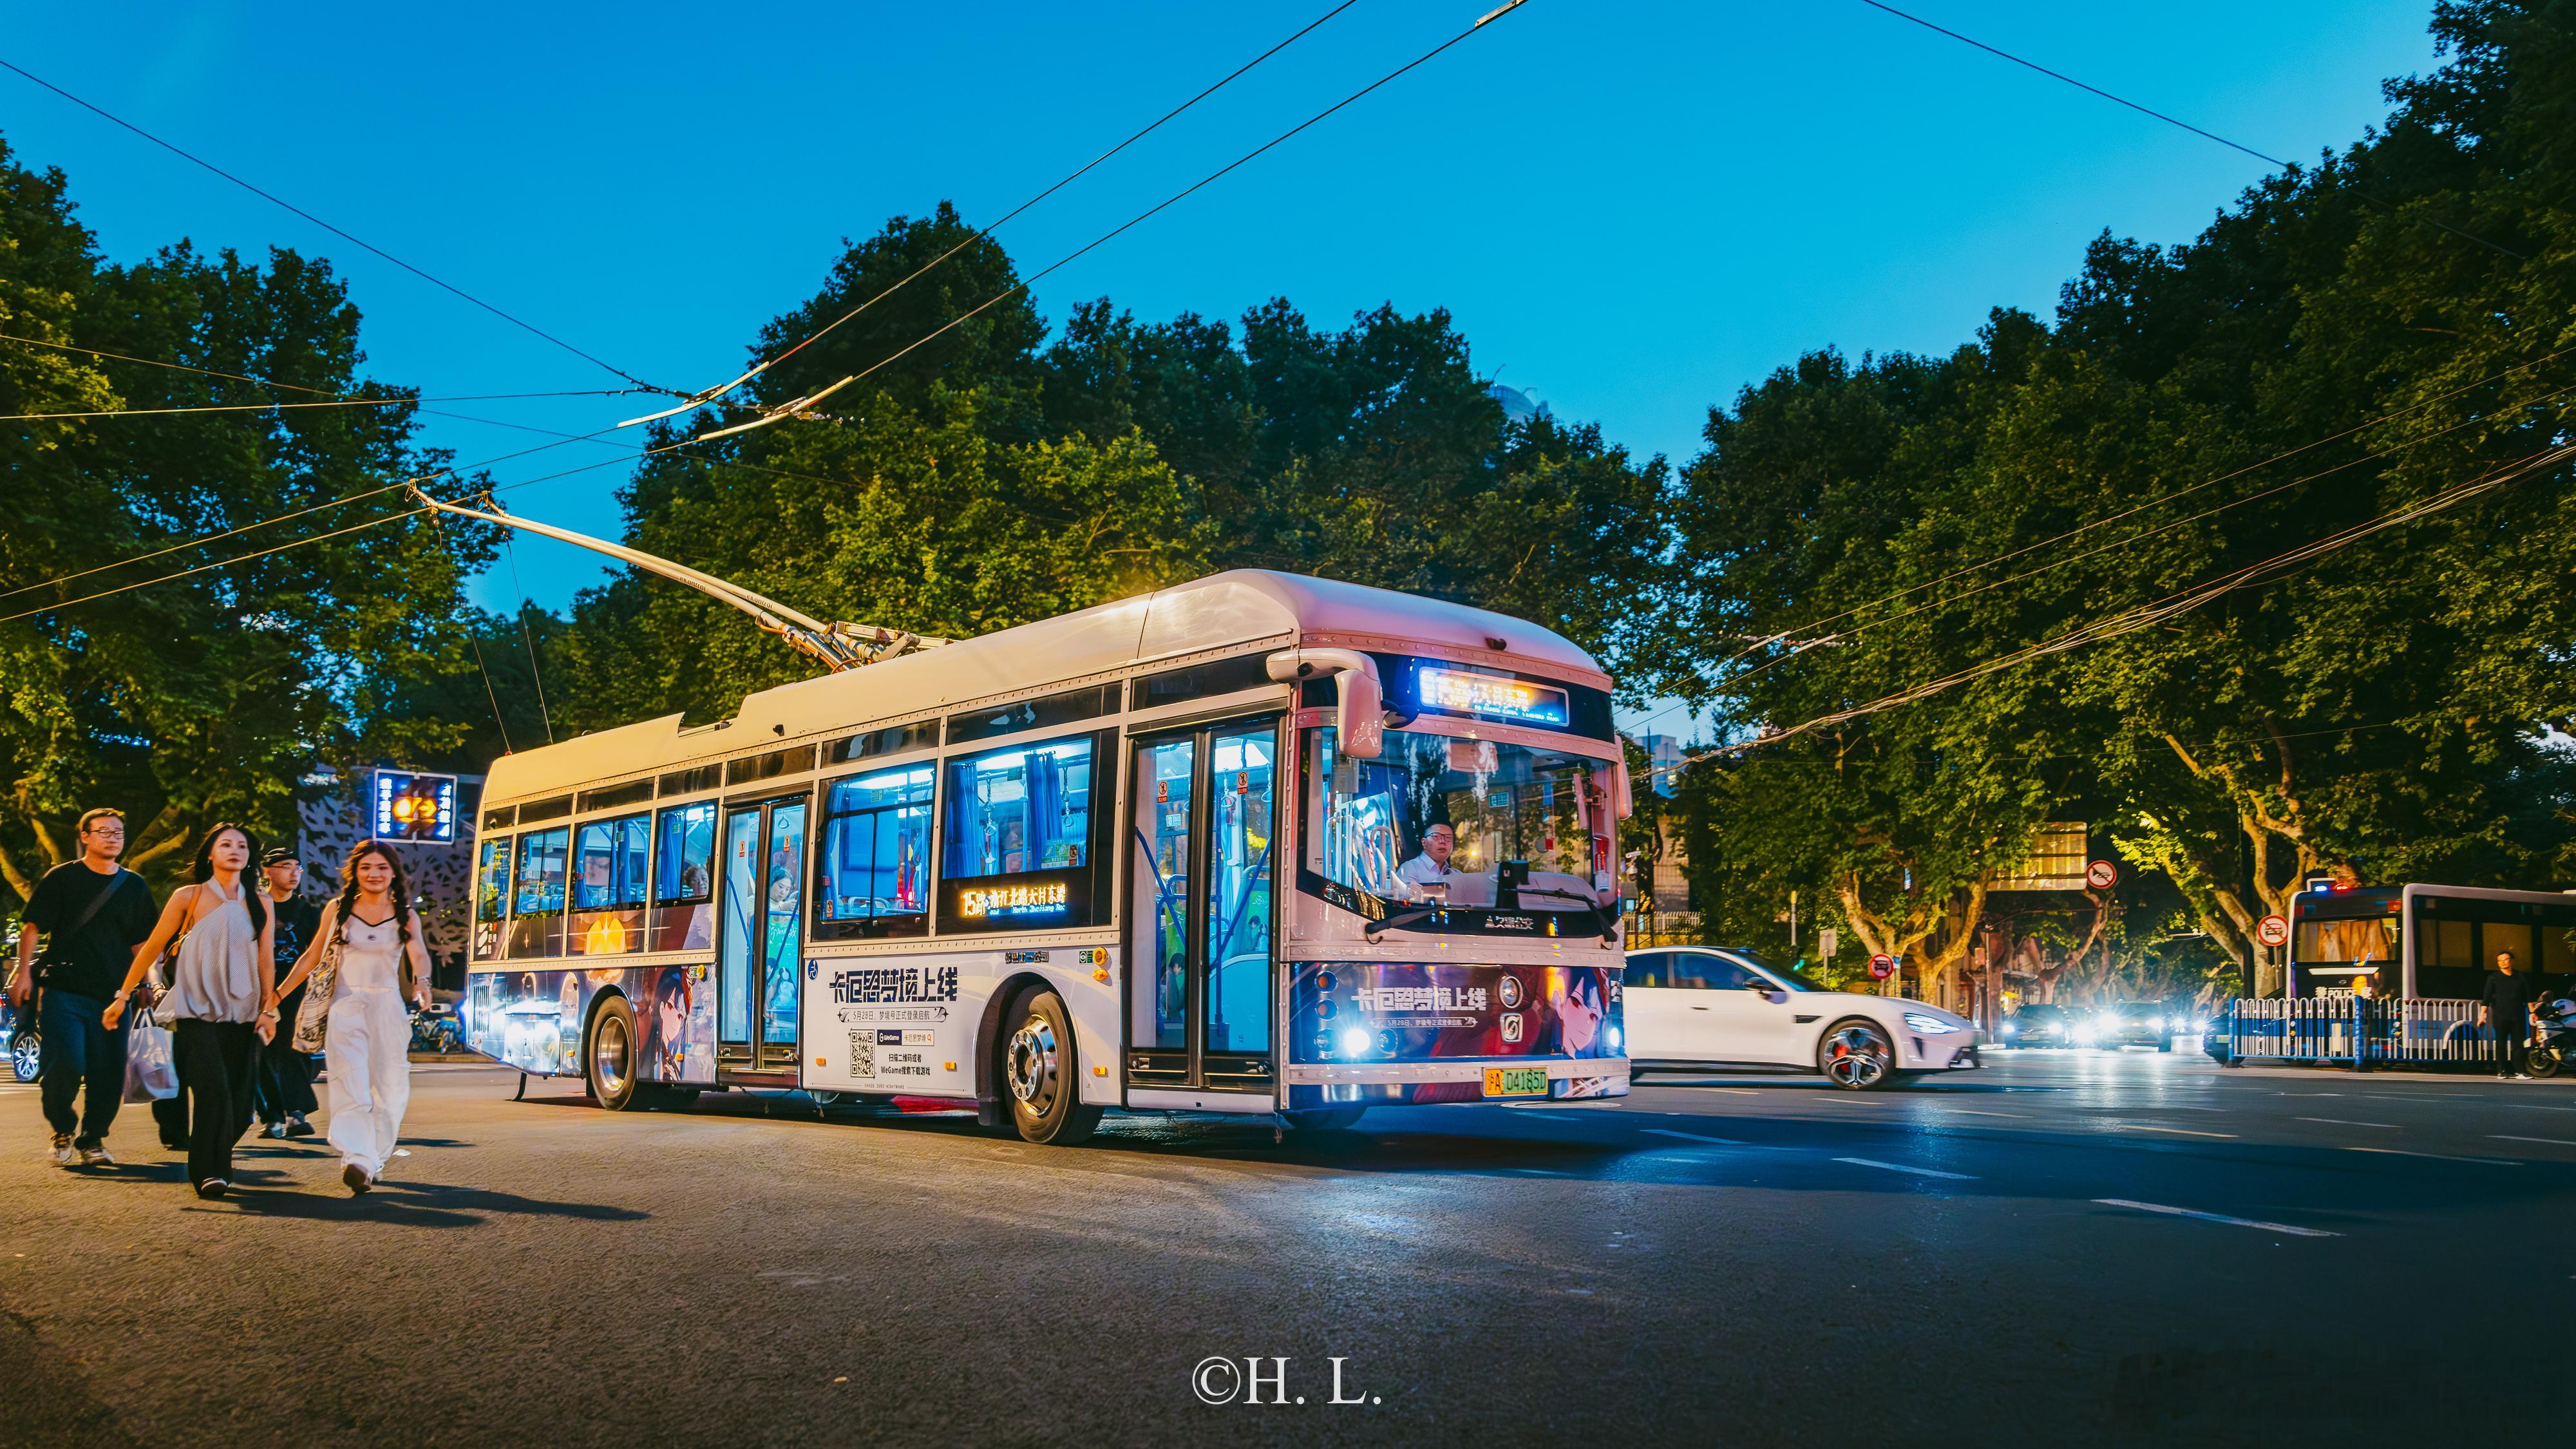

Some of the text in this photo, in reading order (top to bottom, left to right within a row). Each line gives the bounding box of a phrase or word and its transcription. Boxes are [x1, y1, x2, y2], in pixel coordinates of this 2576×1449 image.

[829, 967, 958, 1003] 卡厄思梦境上线
[1350, 987, 1487, 1011] 卡厄思梦境上线
[889, 1054, 922, 1063] 扫描二维码或者
[880, 1066, 931, 1076] WeGame搜索下载游戏
